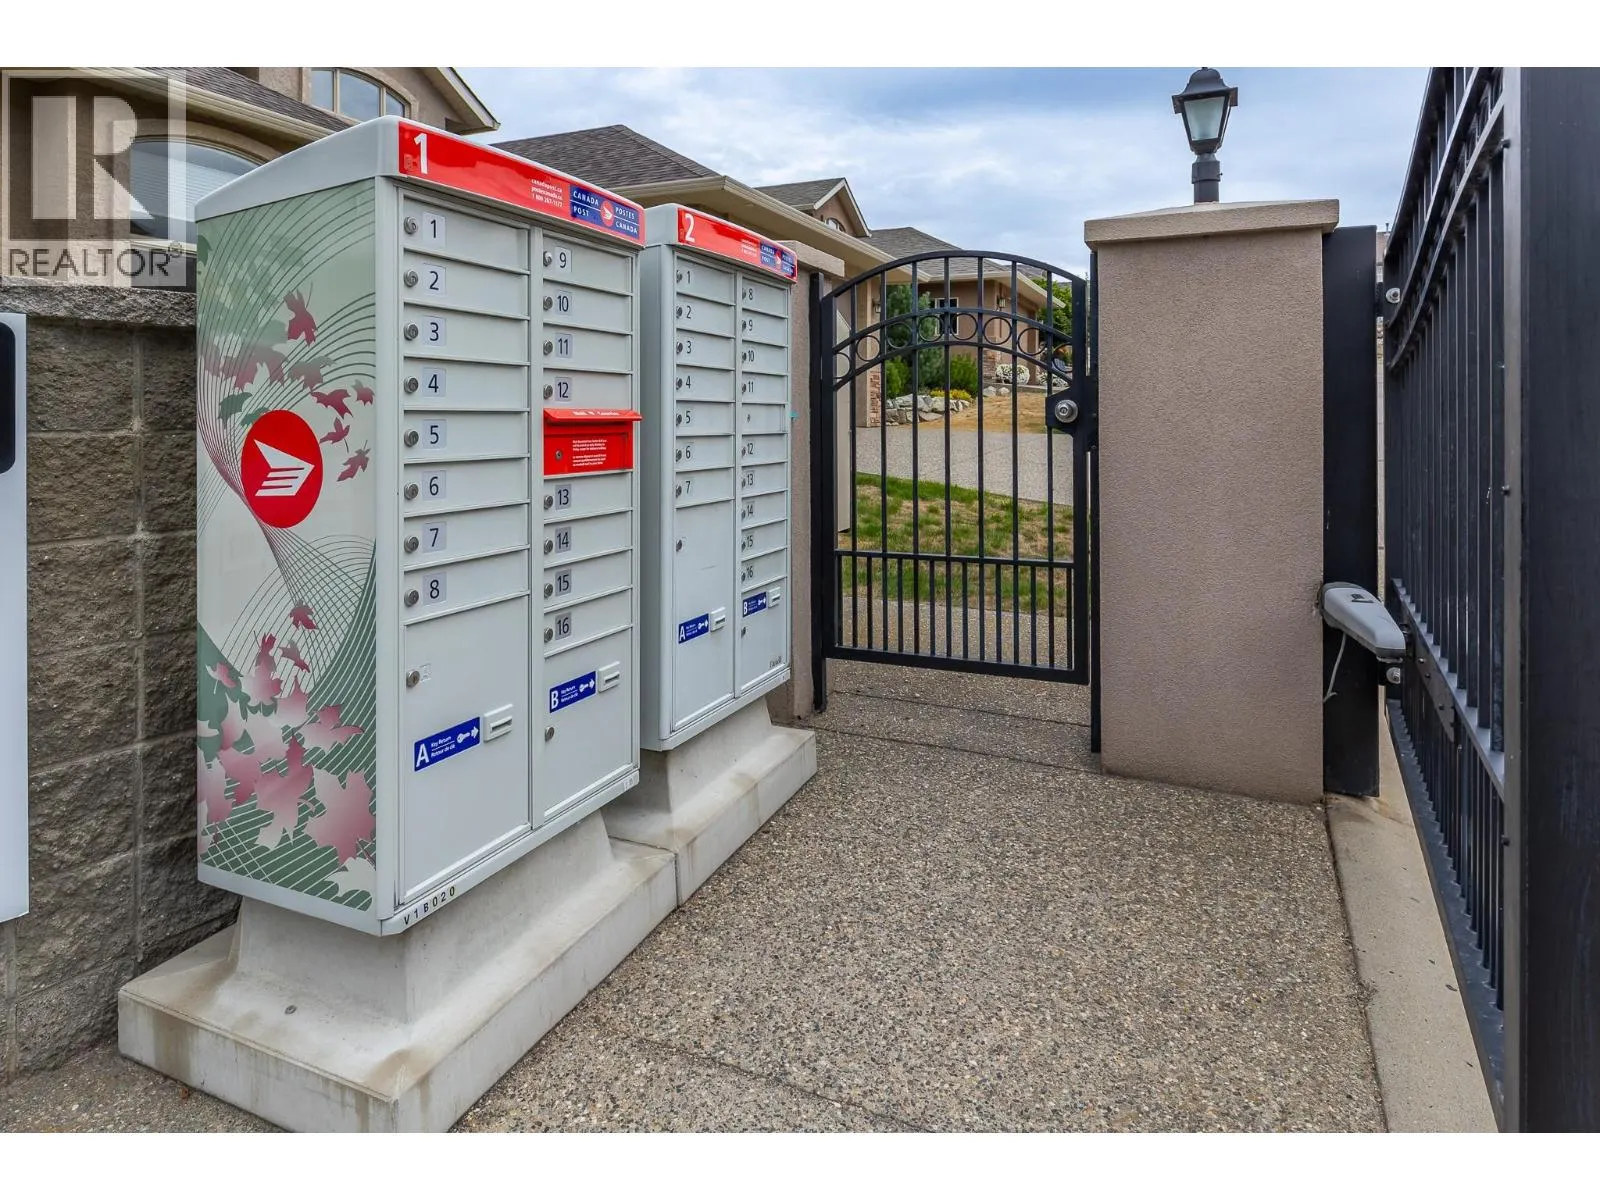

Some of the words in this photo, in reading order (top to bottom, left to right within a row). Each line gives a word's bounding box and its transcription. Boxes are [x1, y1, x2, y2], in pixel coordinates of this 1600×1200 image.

[413, 132, 428, 174] 1
[573, 190, 599, 206] CANADA
[573, 206, 589, 217] POST
[615, 206, 635, 220] POSTES
[430, 219, 437, 239] 1
[615, 221, 638, 235] CANADA
[684, 213, 695, 243] 2
[559, 252, 567, 269] 9
[429, 270, 439, 291] 2
[687, 270, 691, 284] 1
[748, 288, 753, 300] 8
[557, 294, 569, 312] 10
[686, 305, 692, 319] 2
[429, 322, 439, 342] 3
[748, 319, 753, 331] 9
[558, 338, 568, 355] 11
[686, 340, 692, 354] 3
[747, 350, 755, 362] 10
[428, 374, 439, 393] 4
[557, 381, 569, 398] 12
[685, 375, 691, 389] 4
[747, 381, 754, 393] 11
[685, 410, 691, 424] 5
[430, 425, 439, 444] 5
[685, 445, 691, 459] 6
[746, 442, 754, 455] 12
[429, 476, 439, 496] 6
[685, 480, 691, 494] 7
[746, 473, 754, 486] 13
[557, 488, 569, 506] 13
[746, 504, 754, 517] 14
[429, 527, 439, 547] 7
[556, 531, 569, 550] 14
[746, 535, 754, 548] 15
[746, 565, 754, 578] 16
[429, 579, 440, 599] 8
[557, 574, 569, 592] 15
[743, 601, 748, 615] B
[556, 617, 569, 635] 16
[679, 625, 686, 641] A
[551, 690, 559, 709] B
[416, 743, 429, 767] A
